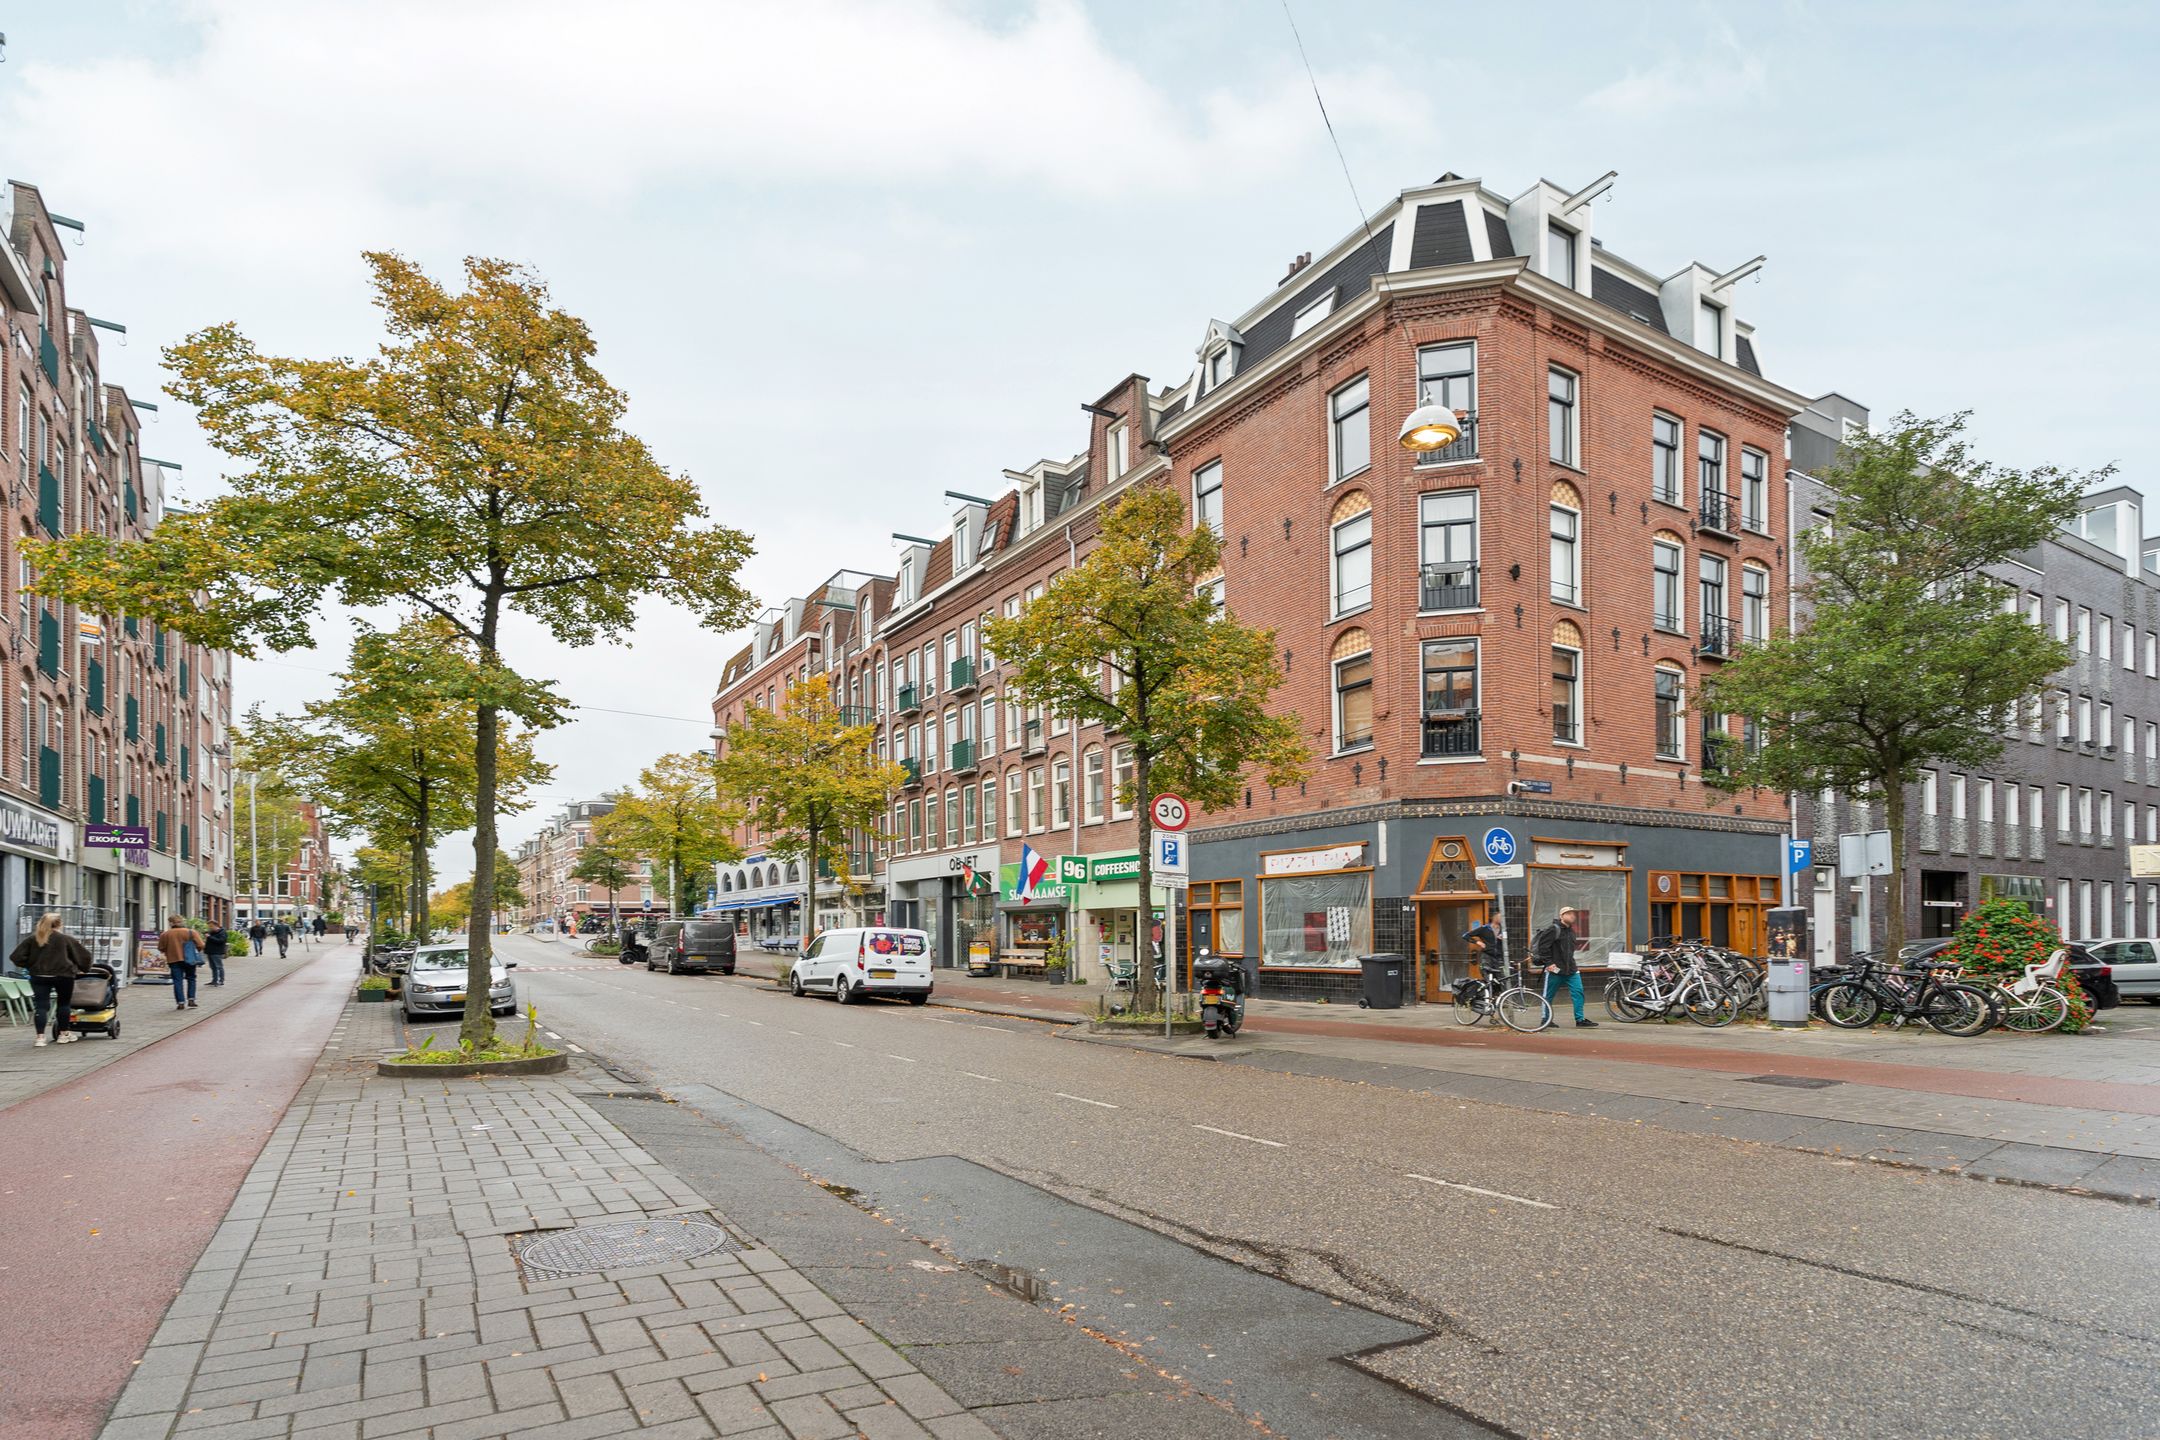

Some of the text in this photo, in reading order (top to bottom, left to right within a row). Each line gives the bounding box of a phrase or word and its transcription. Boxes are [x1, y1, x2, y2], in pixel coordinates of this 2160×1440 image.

[1159, 804, 1182, 819] 30
[0, 807, 57, 849] UWMARKT
[88, 835, 144, 844] EKOPLAZA
[1165, 842, 1175, 855] P
[1794, 850, 1804, 863] P
[1063, 860, 1085, 879] 96
[1094, 860, 1140, 876] COFFEESHO
[1008, 886, 1067, 901] SUAAMSE
